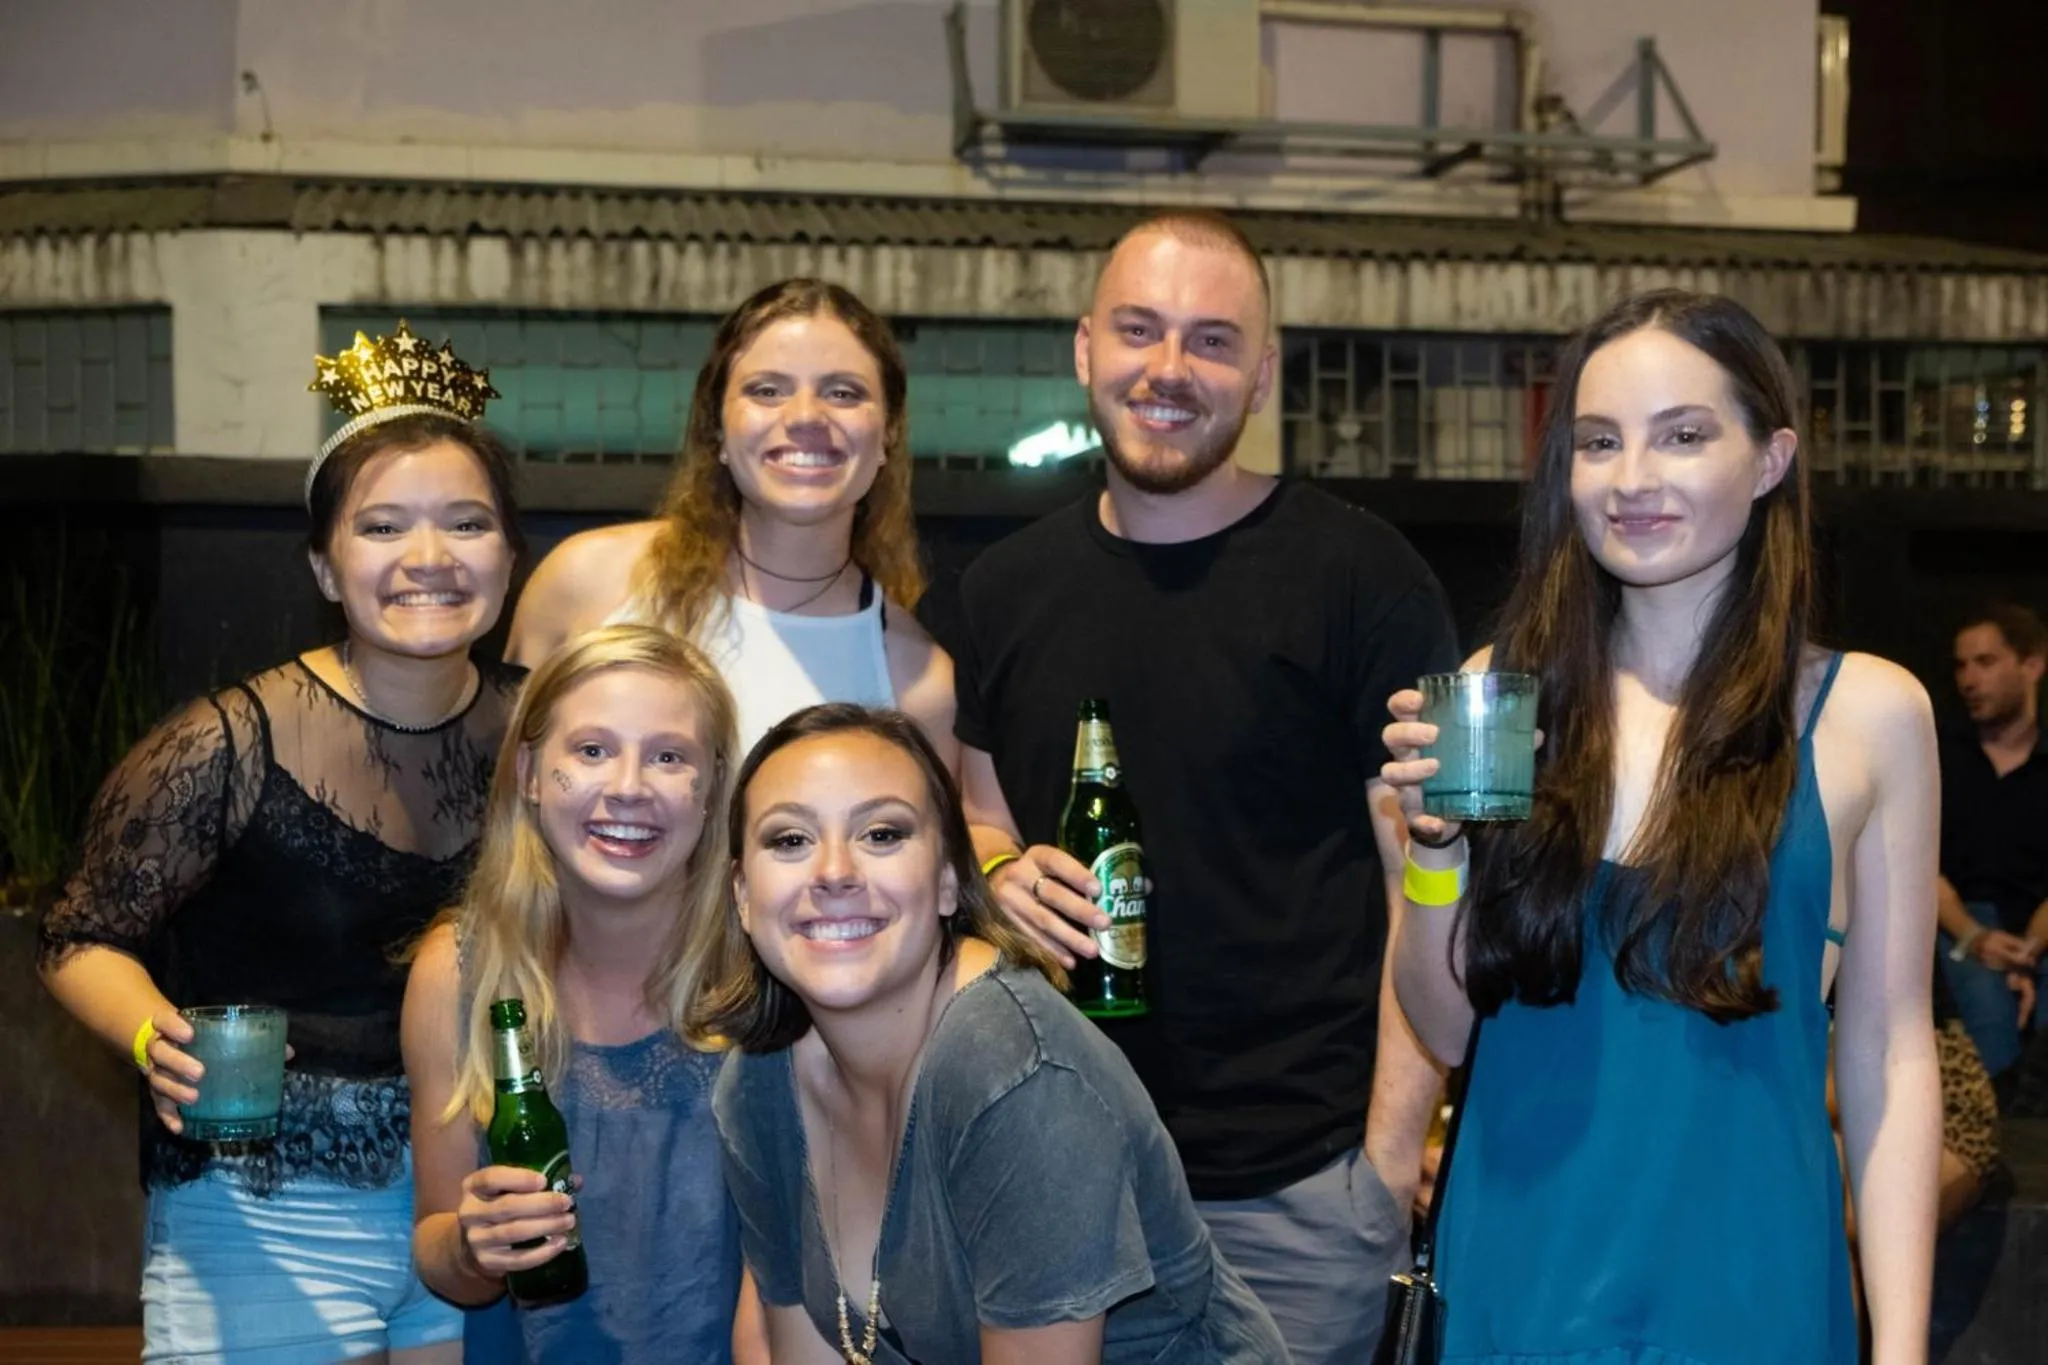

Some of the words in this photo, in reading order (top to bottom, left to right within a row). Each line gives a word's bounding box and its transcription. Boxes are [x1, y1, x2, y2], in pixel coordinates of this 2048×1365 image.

[359, 357, 457, 386] HAPPY
[350, 380, 405, 412] NEW
[410, 381, 472, 417] YEAR
